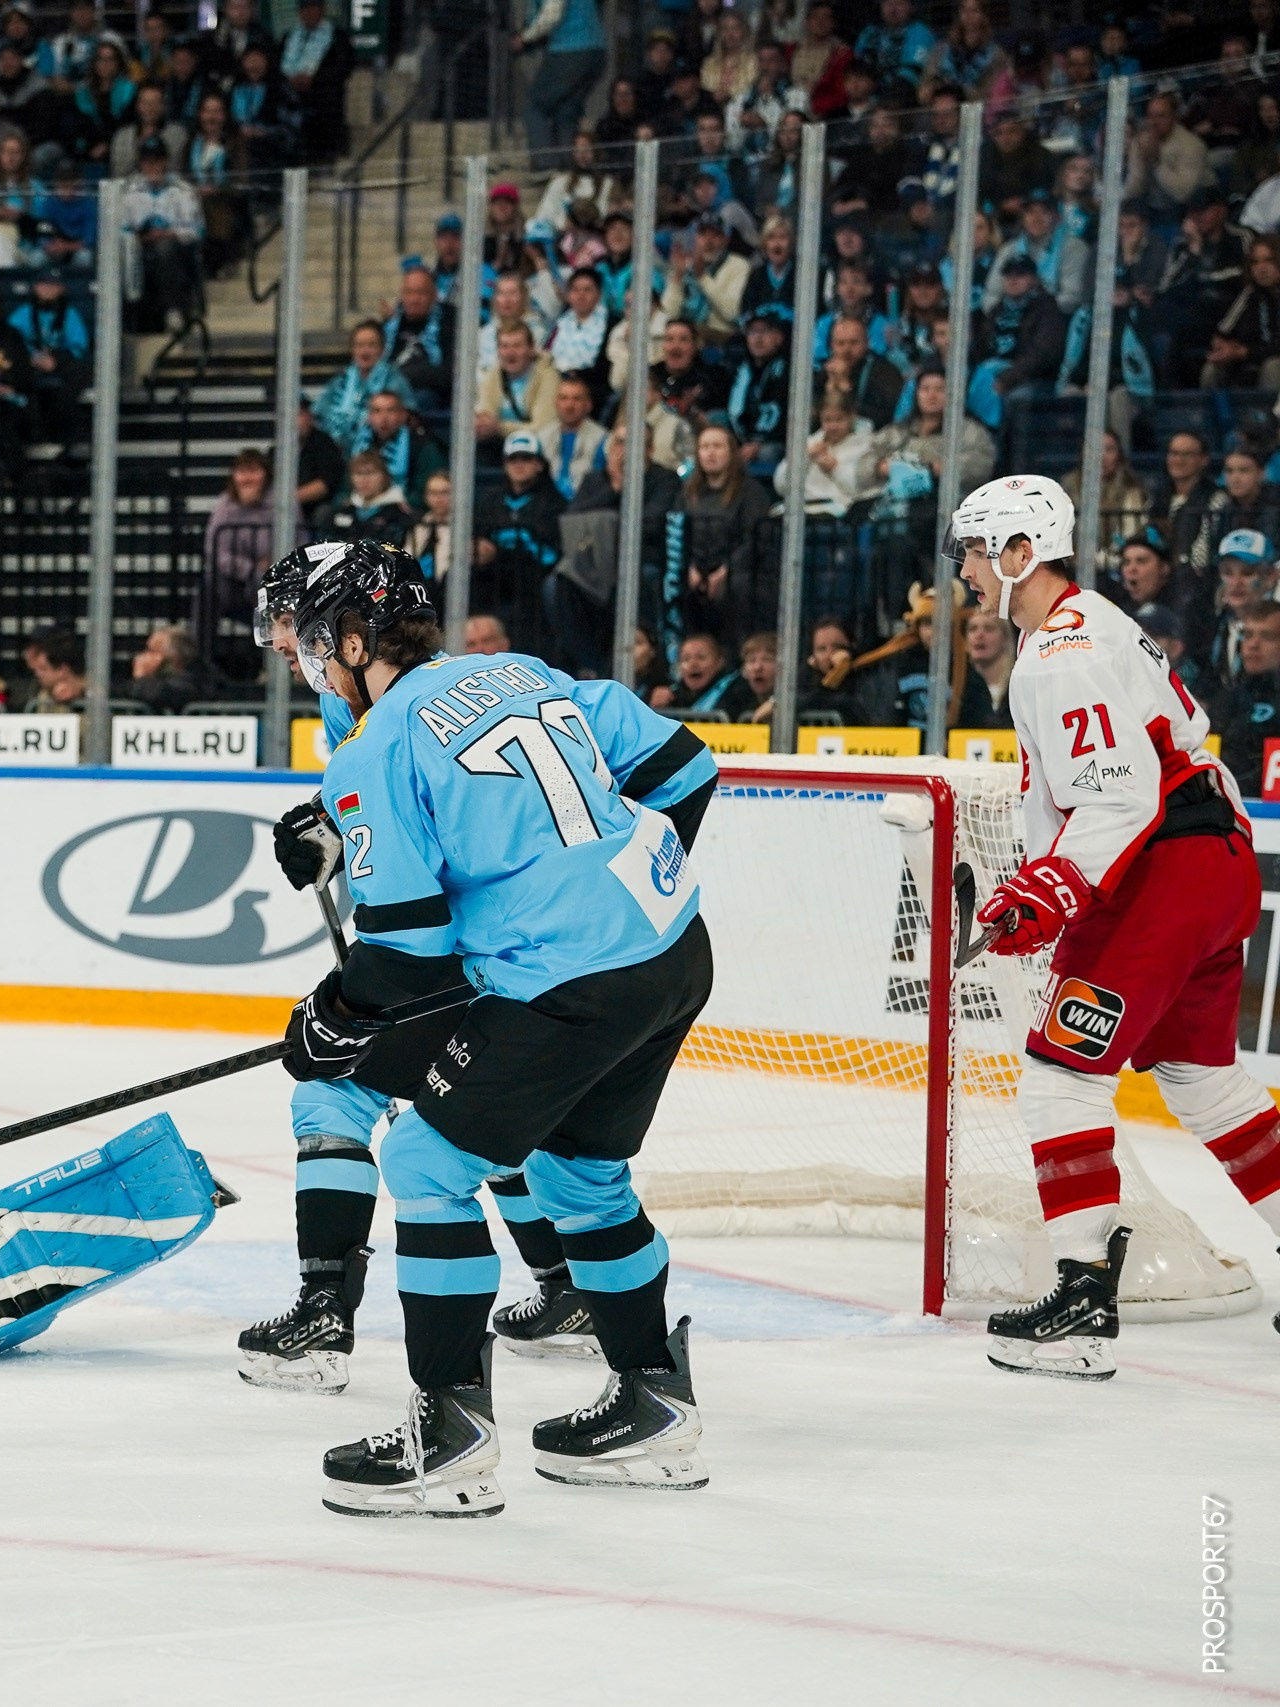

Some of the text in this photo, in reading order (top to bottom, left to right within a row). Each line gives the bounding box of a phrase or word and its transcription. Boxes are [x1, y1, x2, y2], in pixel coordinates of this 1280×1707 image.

[409, 584, 431, 604] 72
[123, 730, 246, 755] KHL.RU
[1062, 703, 1116, 759] 21
[1066, 1004, 1114, 1037] WIN
[13, 1150, 103, 1196] TRUE
[555, 1308, 584, 1333] CCM
[1034, 1297, 1090, 1337] CCM
